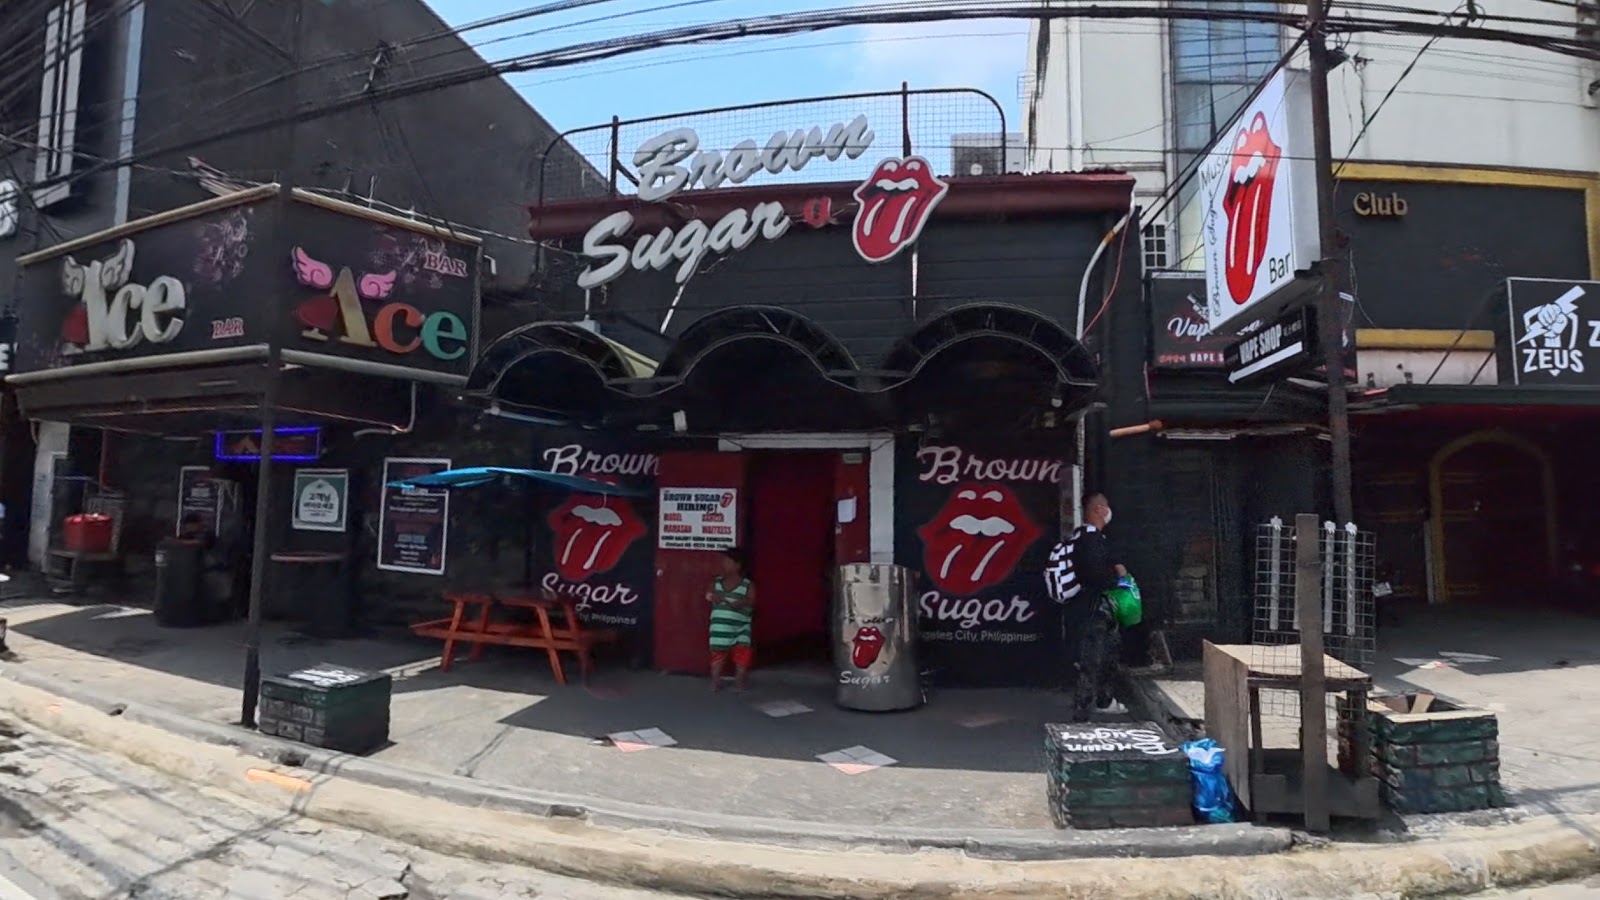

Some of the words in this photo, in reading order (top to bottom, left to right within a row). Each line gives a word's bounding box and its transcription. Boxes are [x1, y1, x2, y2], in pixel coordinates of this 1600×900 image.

[633, 114, 875, 202] Brown
[1353, 192, 1409, 216] Club
[577, 200, 791, 289] Sugar
[424, 251, 468, 277] BAR
[1268, 252, 1291, 284] Bar
[211, 317, 245, 339] BAR
[1238, 335, 1261, 365] VAPE
[1259, 324, 1283, 355] SHOP
[1190, 353, 1214, 362] VAPE
[1522, 348, 1585, 373] ZEUS
[543, 444, 661, 475] Brown
[916, 446, 1062, 484] Brown
[677, 503, 718, 512] HIRING!
[694, 493, 720, 502] SUGAR
[541, 572, 638, 611] Sugar
[919, 590, 1035, 629] Sugar
[955, 630, 979, 642] City,
[981, 631, 1037, 643] Philippines
[840, 670, 891, 689] Sugar
[1060, 727, 1161, 742] Sugar
[1064, 741, 1180, 755] Brown
